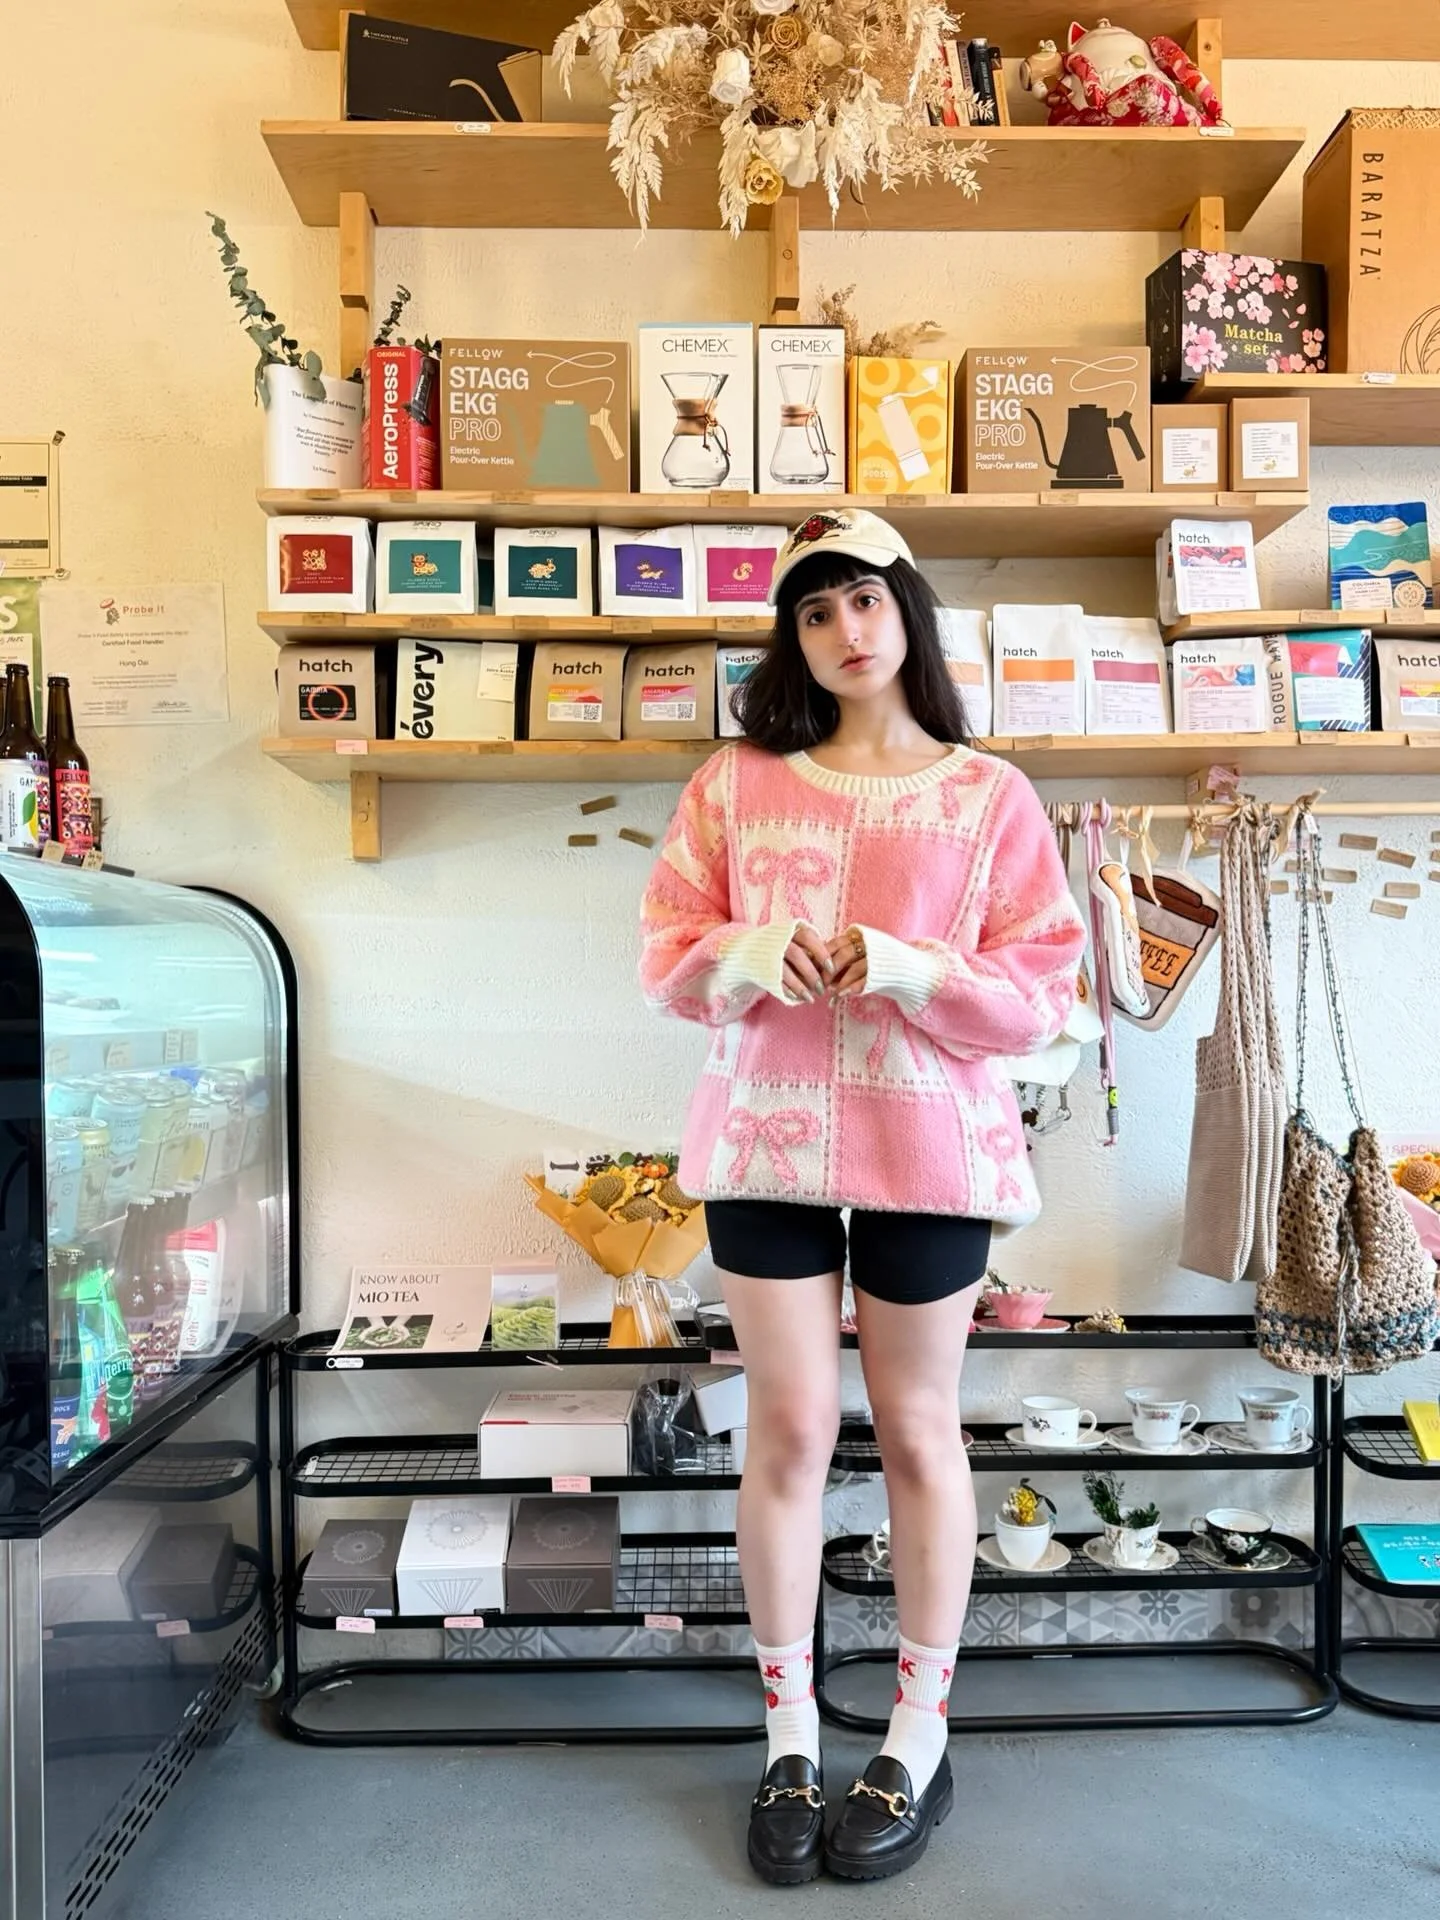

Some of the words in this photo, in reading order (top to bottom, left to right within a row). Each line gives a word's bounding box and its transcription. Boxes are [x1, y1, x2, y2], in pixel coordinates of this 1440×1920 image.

[1359, 153, 1384, 276] BARATZA
[1224, 323, 1284, 343] Matcha
[661, 339, 728, 353] CHEMEX
[770, 338, 832, 353] CHEMEX
[1243, 343, 1269, 355] set
[450, 348, 503, 360] FELLOW
[975, 356, 1028, 367] FELLOW
[449, 366, 529, 390] STAGG
[975, 373, 1054, 396] STAGG
[449, 392, 498, 415] EKG
[975, 398, 1022, 421] EKG
[383, 363, 399, 480] AeroPress
[449, 417, 502, 441] PRO
[975, 423, 1026, 447] PRO
[450, 446, 480, 455] Electric
[975, 452, 1005, 461] Electric
[450, 456, 490, 465] Pour-Over
[490, 457, 514, 465] Kettle
[975, 462, 1014, 470] Pour-Over
[1015, 461, 1039, 470] Kettle
[1178, 532, 1211, 544] hatch
[122, 605, 154, 614] Probe
[1003, 647, 1037, 658] hatch
[1091, 647, 1124, 659] hatch
[1180, 653, 1216, 664] hatch
[299, 659, 353, 672] hatch
[726, 655, 760, 664] hatch
[552, 661, 602, 675] hatch
[644, 664, 695, 677] hatch
[1270, 671, 1287, 724] ROGUE
[60, 773, 84, 782] JELLY
[359, 1274, 398, 1285] KNOW
[400, 1274, 440, 1284] ABOUT
[358, 1291, 389, 1304] MIO
[393, 1291, 419, 1302] TEA
